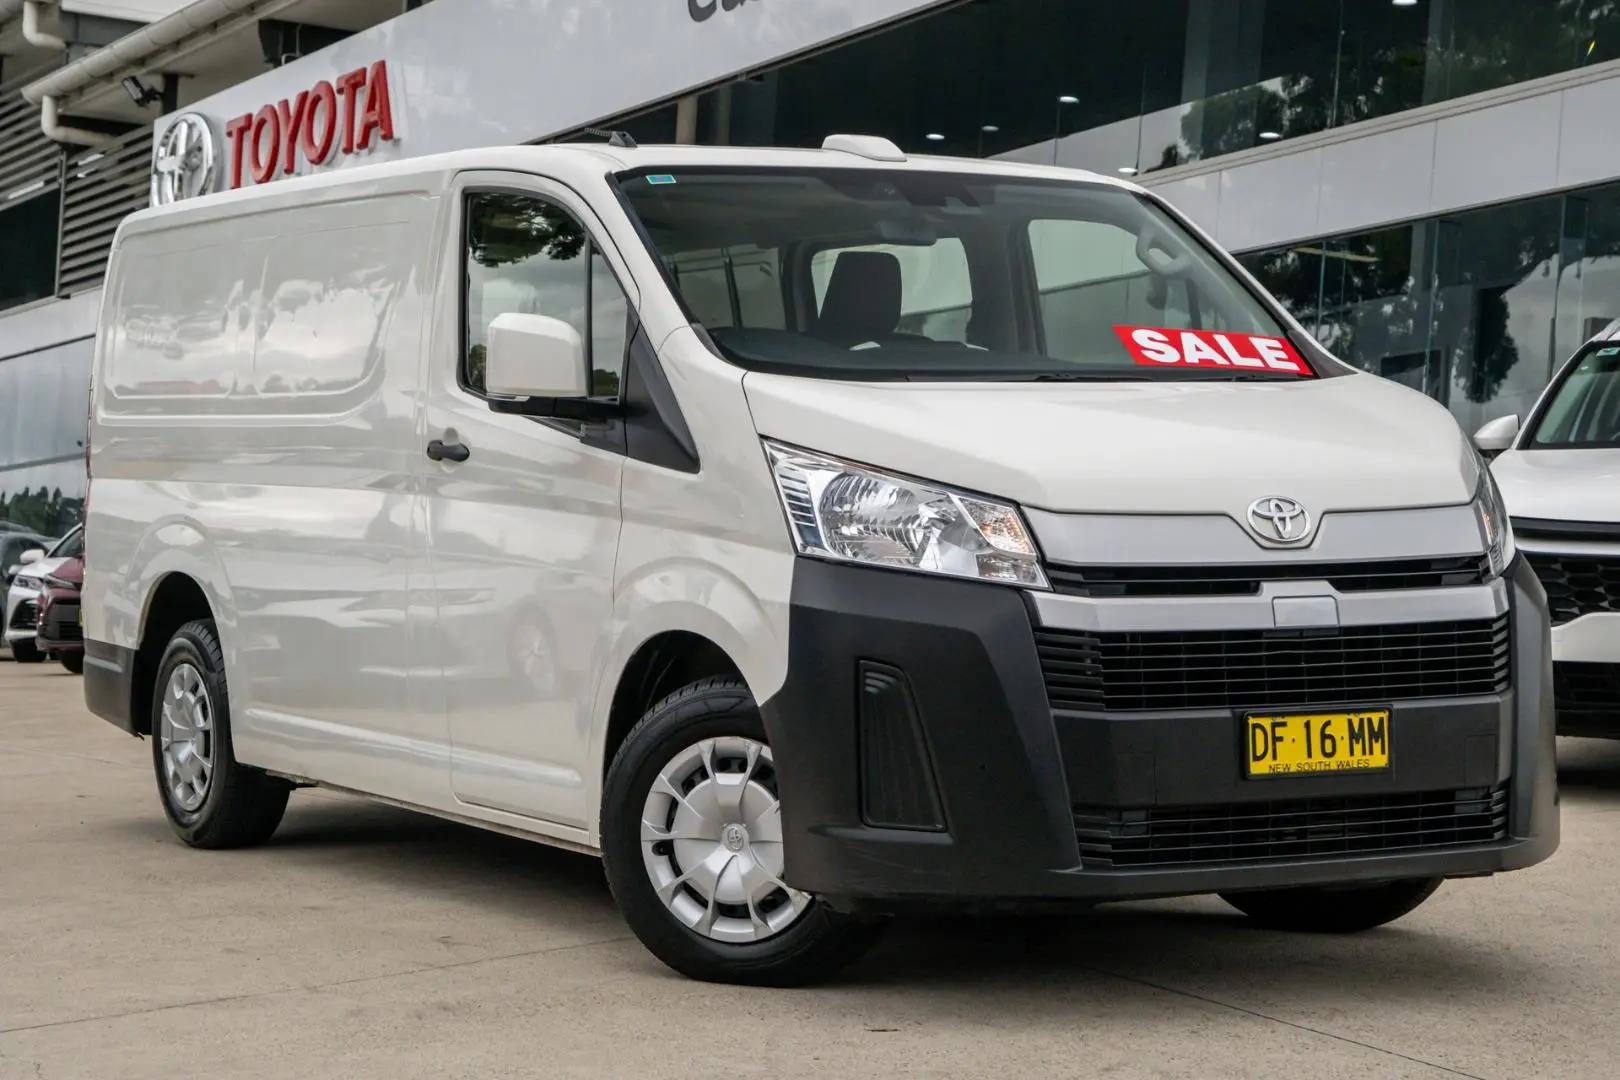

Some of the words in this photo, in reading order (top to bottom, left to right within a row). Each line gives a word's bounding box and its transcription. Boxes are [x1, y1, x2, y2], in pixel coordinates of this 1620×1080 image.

[226, 60, 393, 189] TOYOTA
[1131, 329, 1300, 370] SALE
[1269, 763, 1291, 773] NEW
[1296, 761, 1331, 772] SOUTH
[1336, 759, 1370, 768] WALES
